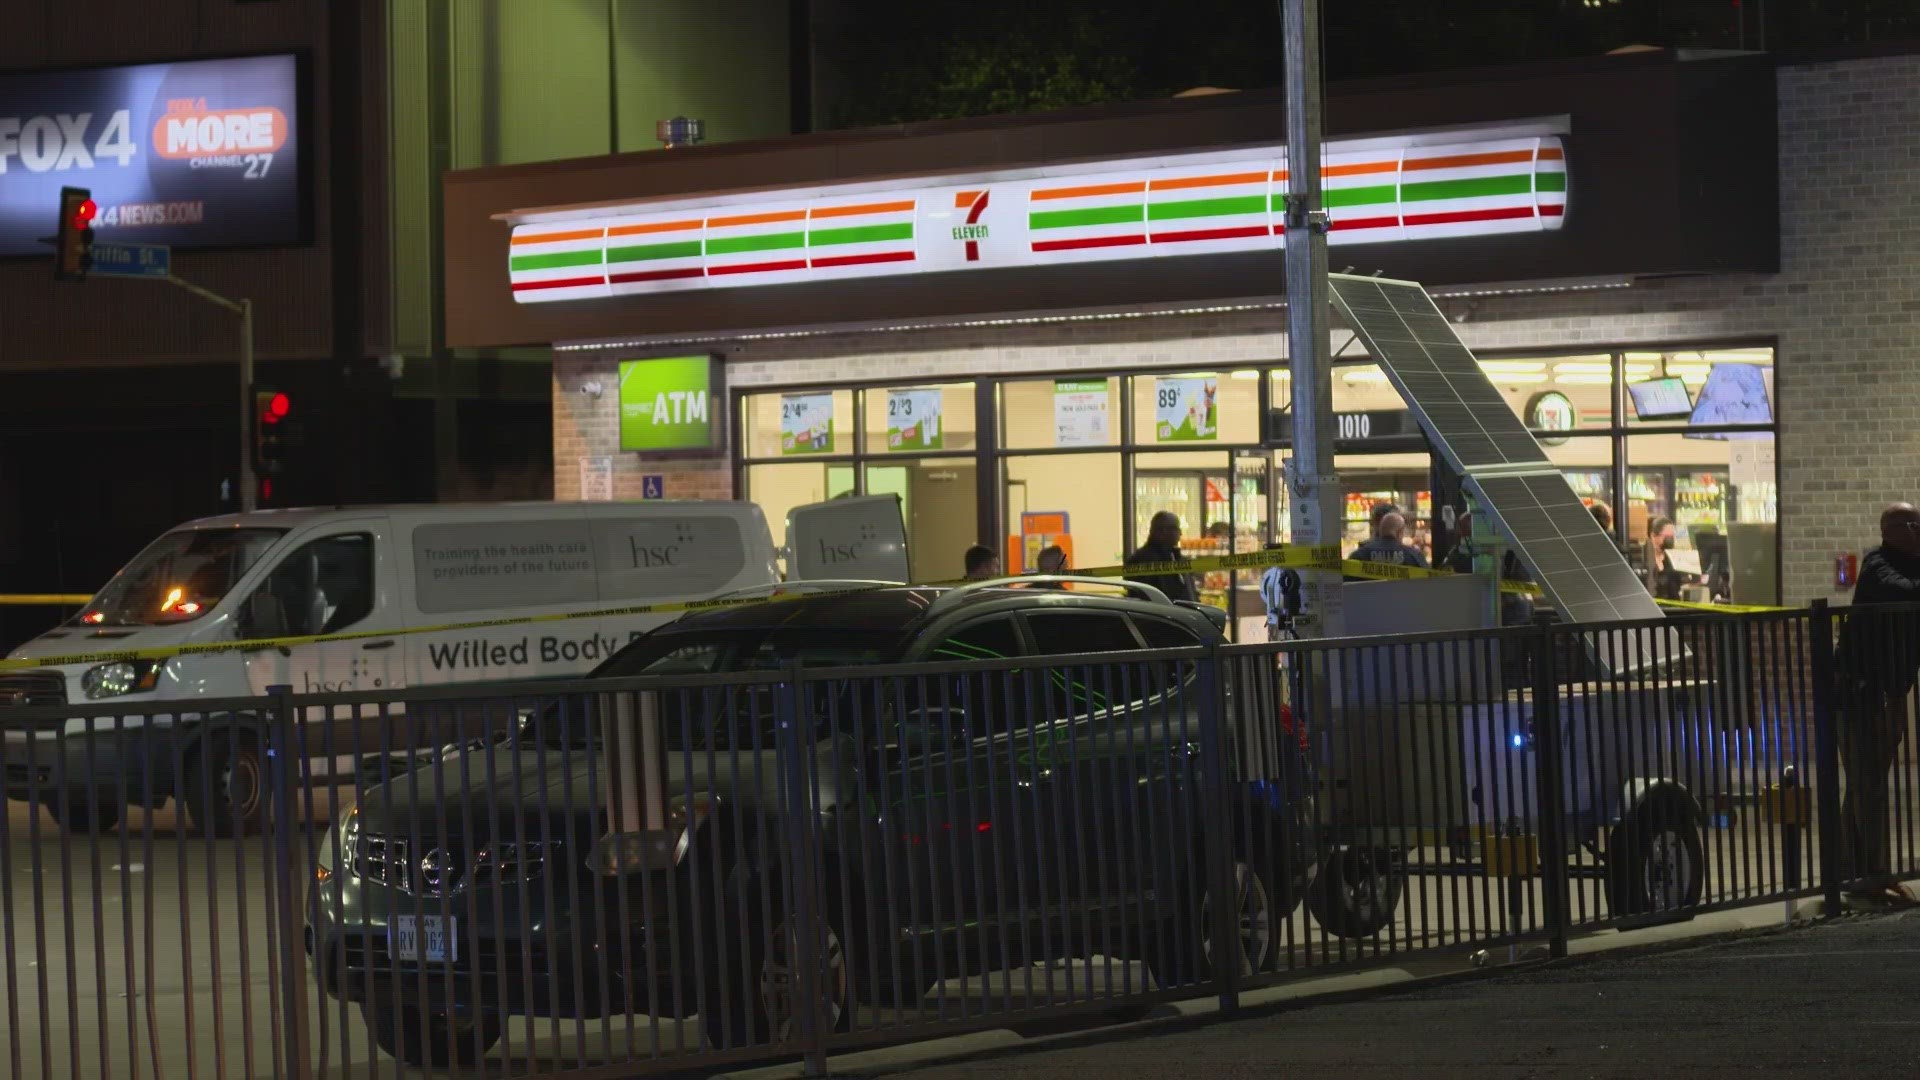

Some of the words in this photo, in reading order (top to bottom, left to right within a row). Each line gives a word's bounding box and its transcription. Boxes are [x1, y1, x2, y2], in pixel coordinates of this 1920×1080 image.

[167, 112, 273, 153] MORE
[190, 157, 243, 170] CHANNEL
[244, 153, 274, 179] 27
[955, 188, 990, 261] 7
[652, 390, 708, 425] ATM
[1338, 414, 1370, 438] 1010
[426, 547, 480, 562] Training
[485, 545, 506, 559] the
[510, 543, 553, 558] health
[557, 543, 588, 555] care
[629, 534, 682, 568] hsc
[818, 538, 862, 564] hsc
[1370, 550, 1405, 564] DALLAS
[433, 562, 500, 580] providers
[504, 561, 518, 575] of
[522, 560, 544, 574] the
[548, 558, 590, 572] future
[429, 636, 529, 671] Willed
[540, 633, 618, 664] Body
